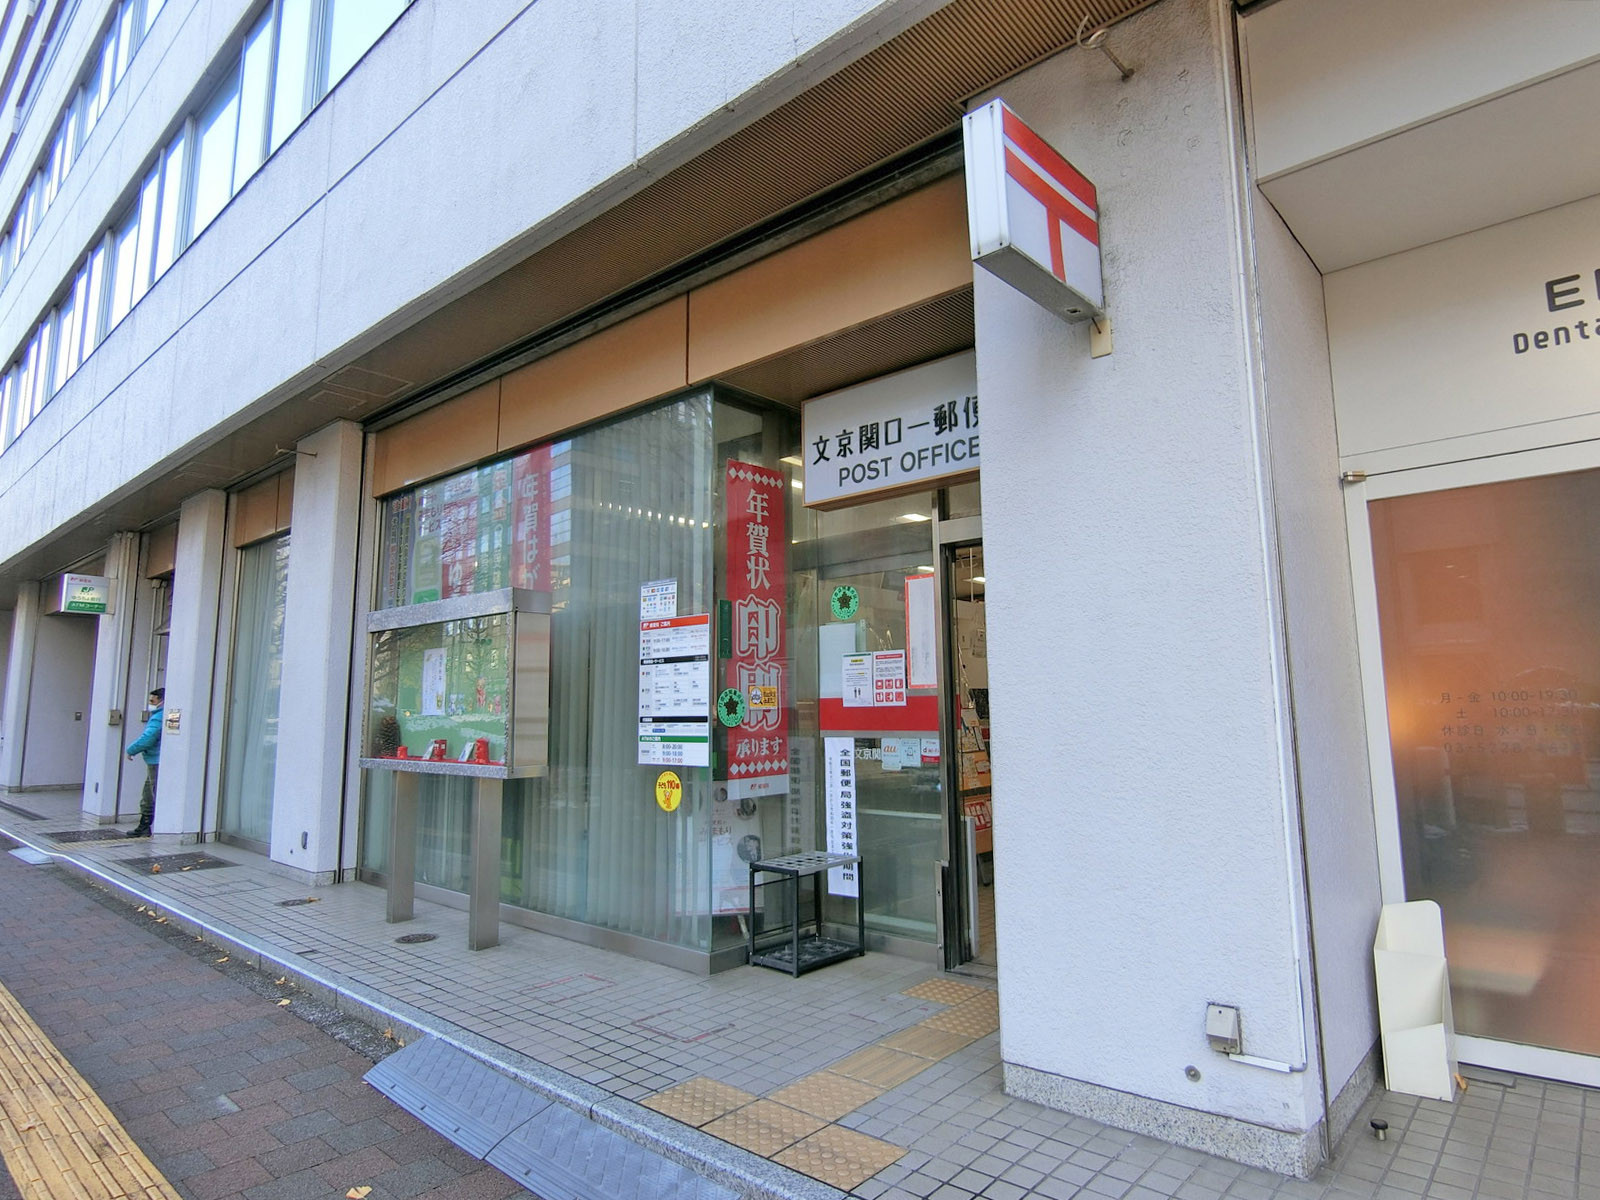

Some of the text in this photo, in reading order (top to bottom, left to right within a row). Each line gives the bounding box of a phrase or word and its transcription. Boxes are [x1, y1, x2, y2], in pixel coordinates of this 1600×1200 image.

[1546, 268, 1600, 312] E
[839, 435, 980, 487] POST OFFICE
[746, 487, 771, 591] 年賀状
[1456, 708, 1467, 719] 土
[736, 737, 783, 758] 承ります
[883, 744, 897, 753] au
